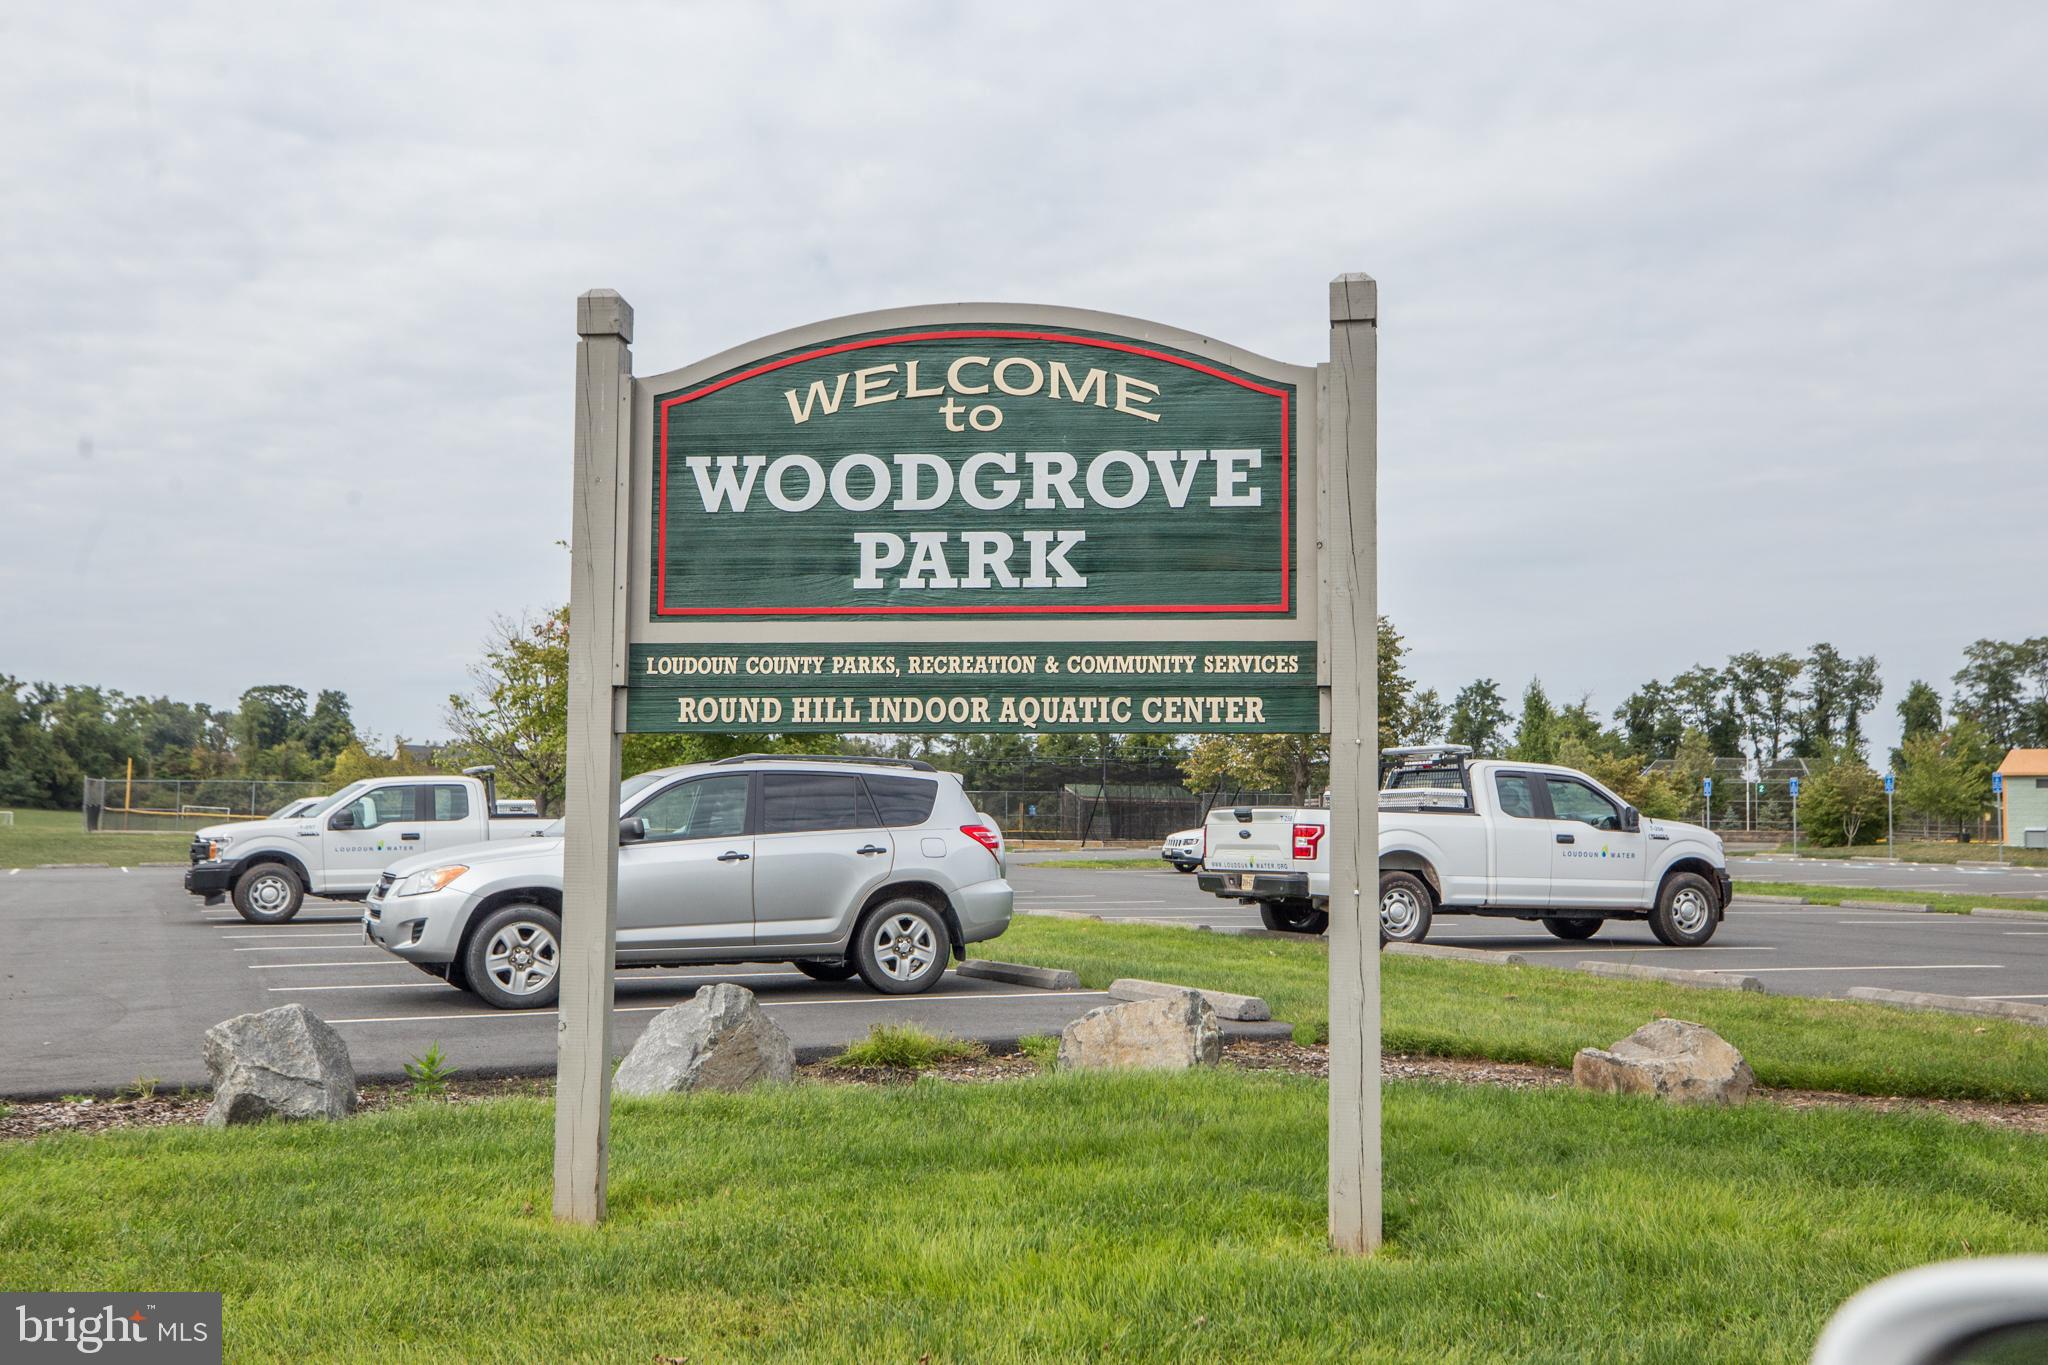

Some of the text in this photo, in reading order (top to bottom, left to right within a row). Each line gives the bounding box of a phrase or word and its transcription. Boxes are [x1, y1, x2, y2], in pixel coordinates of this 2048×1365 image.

[784, 356, 1161, 424] WELCOME
[939, 397, 1004, 432] to
[686, 448, 1262, 513] WOODGROVE
[853, 530, 1088, 590] PARK
[646, 655, 1299, 678] LOUDOUN COUNTY PARKS, RECREATION & COMMUNITY SERVICES
[678, 696, 1266, 729] ROUND HILL INDOOR AQUATIC CENTER
[1562, 850, 1599, 858] LOUDOUN
